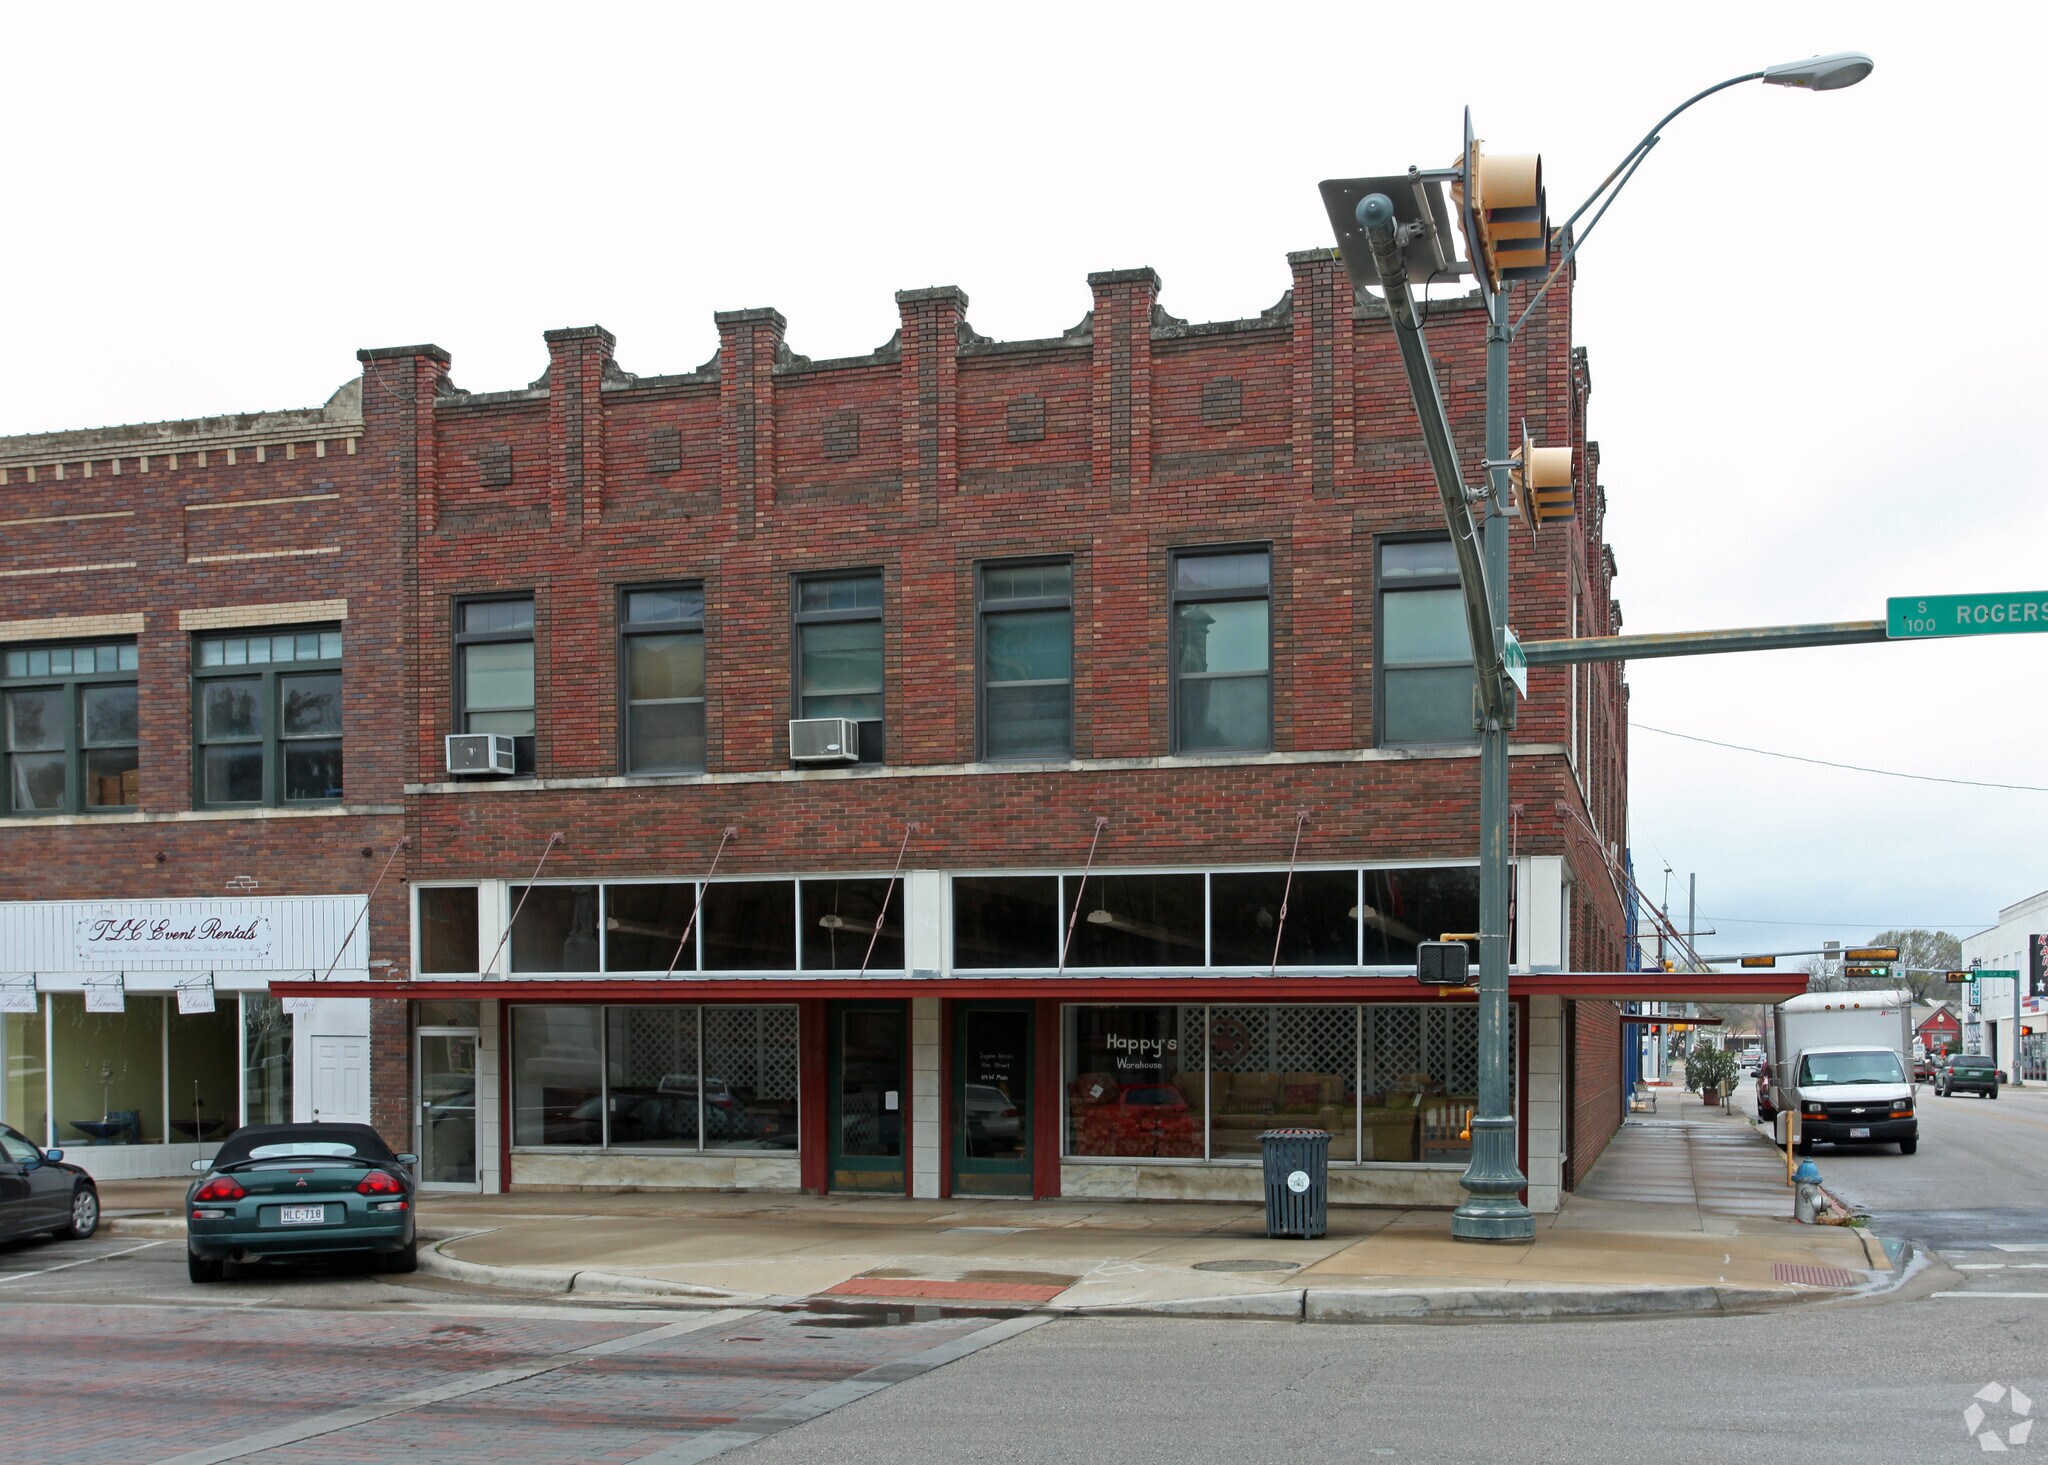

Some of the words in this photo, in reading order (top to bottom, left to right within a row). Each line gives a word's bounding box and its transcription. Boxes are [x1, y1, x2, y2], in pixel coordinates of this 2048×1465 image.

[1917, 601, 1928, 614] S
[1908, 618, 1936, 632] 100
[88, 918, 147, 942] TLC
[146, 918, 197, 941] Event
[198, 917, 259, 941] Rentals
[447, 1018, 458, 1026] 102
[1106, 1033, 1178, 1058] Happy's
[1116, 1056, 1163, 1069] Warehouse
